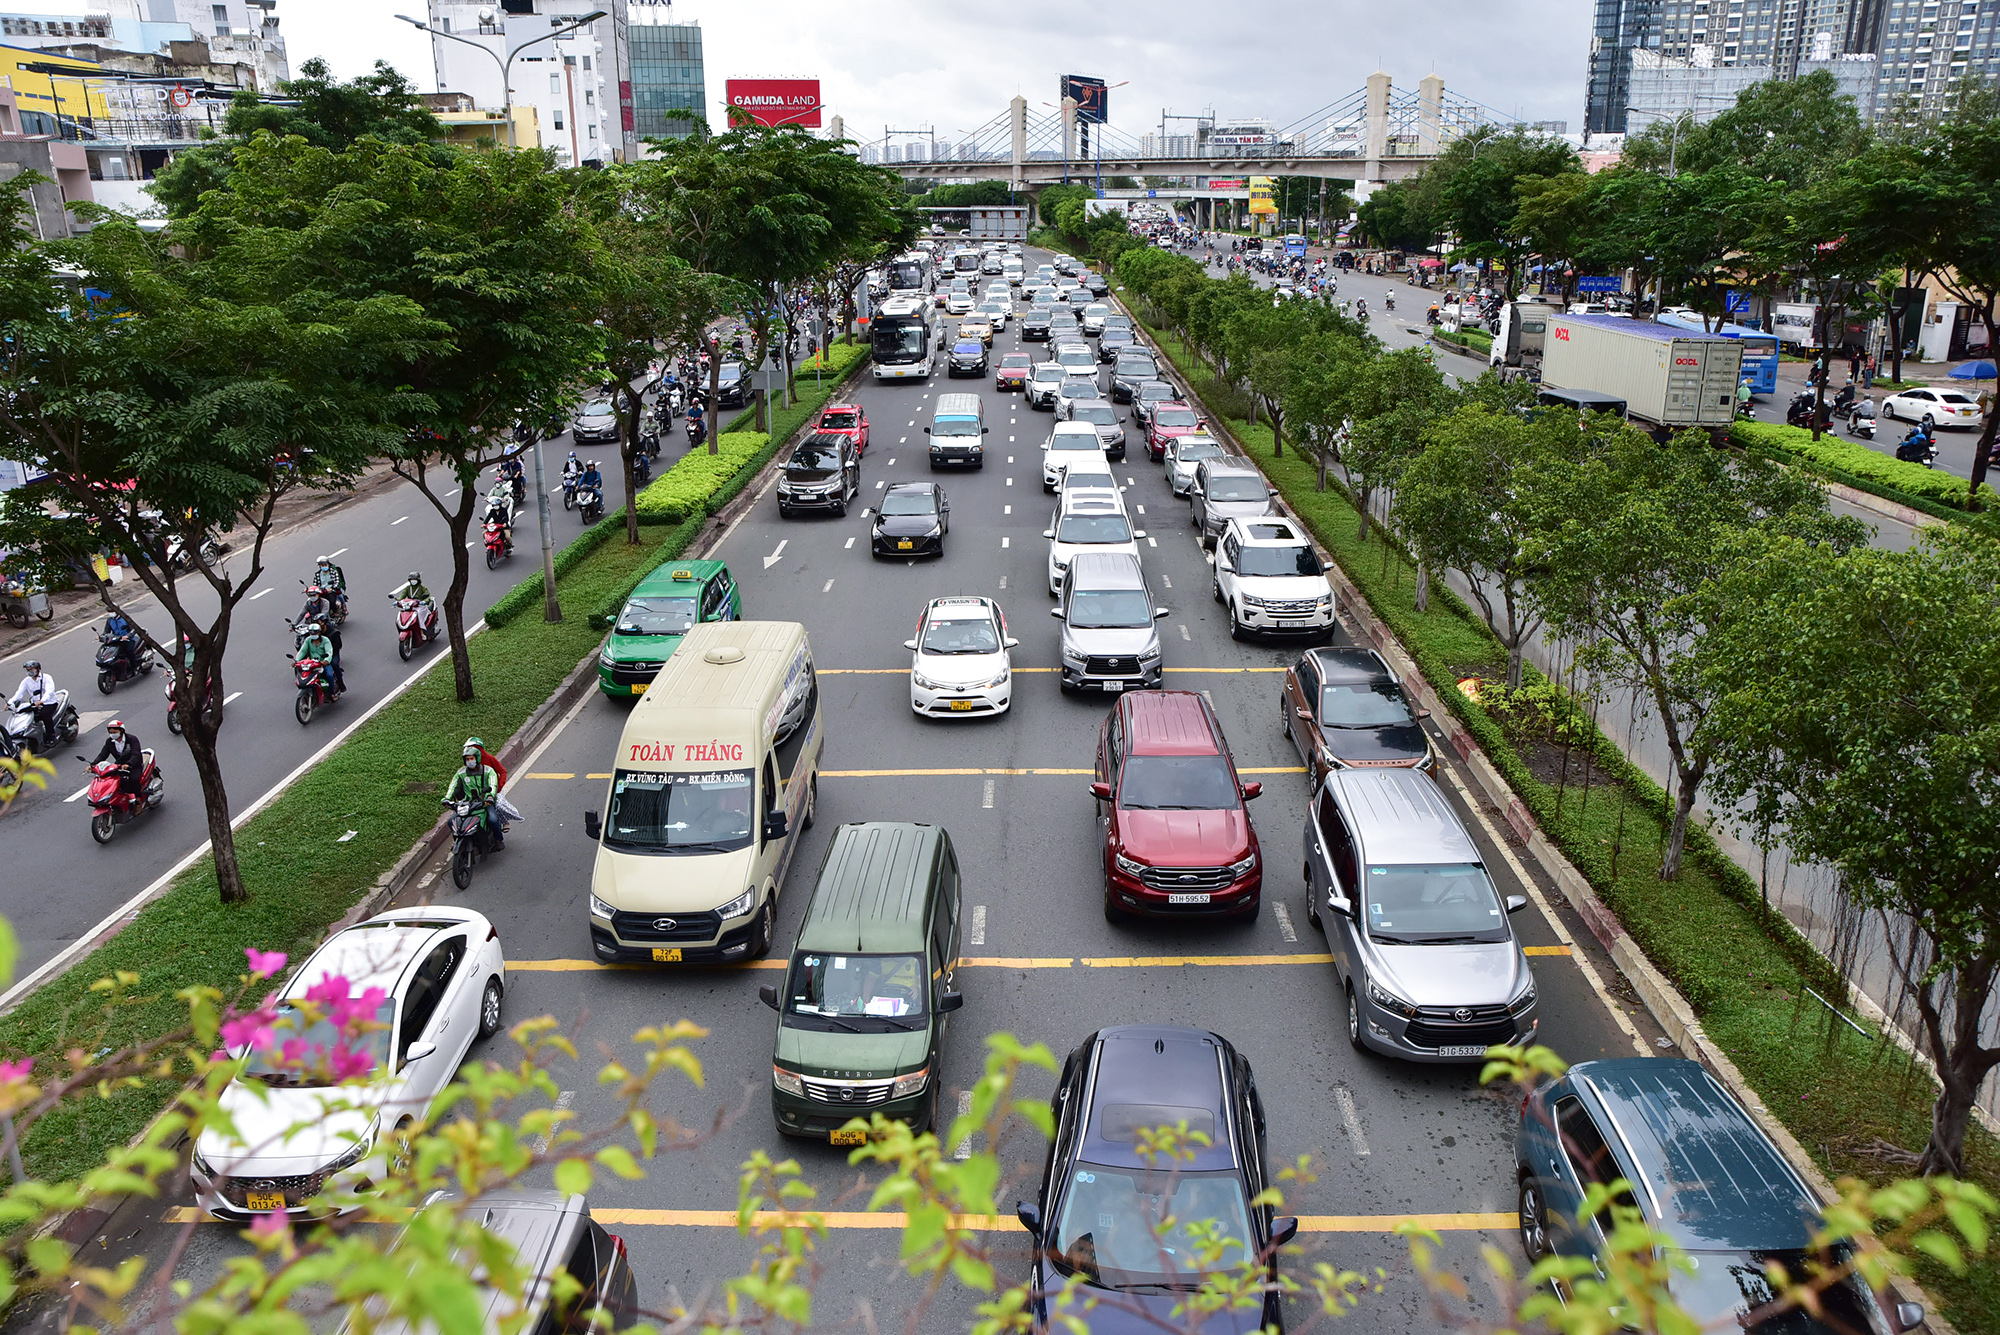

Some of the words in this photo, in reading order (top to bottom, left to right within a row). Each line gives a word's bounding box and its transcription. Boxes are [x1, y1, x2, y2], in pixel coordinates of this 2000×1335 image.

[734, 95, 784, 106] GAMUDA
[787, 95, 816, 106] LAND
[160, 111, 192, 121] Drinks
[1225, 136, 1238, 144] KHOA
[1555, 327, 1570, 341] OOCL
[1675, 358, 1698, 366] OOCL
[630, 741, 675, 761] TOÀN
[684, 739, 743, 761] THẮNG
[658, 773, 673, 784] TÀU
[724, 772, 745, 783] ĐÔNG
[822, 1070, 873, 1078] KENBO
[257, 1193, 274, 1201] 50E
[251, 1201, 282, 1209] 013.45
